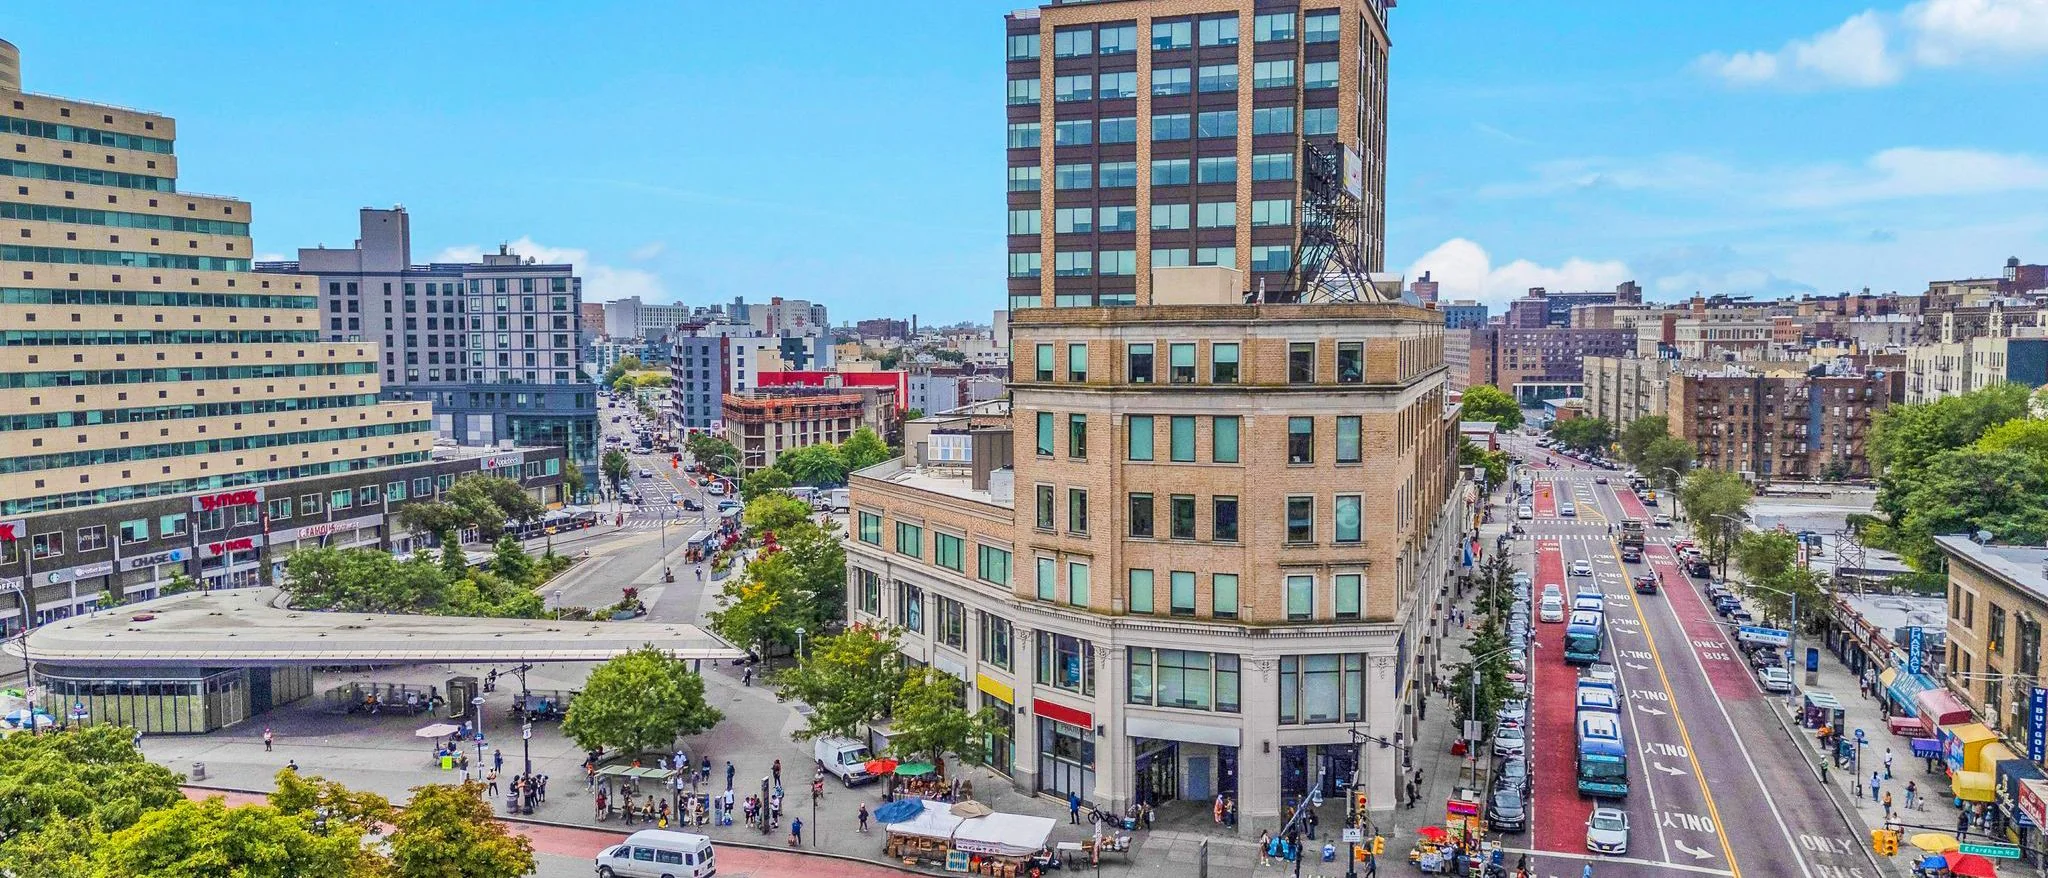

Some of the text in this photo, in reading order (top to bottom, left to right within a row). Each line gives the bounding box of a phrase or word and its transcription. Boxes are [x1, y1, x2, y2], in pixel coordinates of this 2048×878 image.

[132, 554, 169, 567] CHASE
[1610, 618, 1640, 626] ONLY
[1692, 639, 1727, 649] ONLY
[1619, 650, 1653, 659] ONLY
[1702, 651, 1732, 661] BUS
[1910, 627, 1921, 674] PHARMACY
[1630, 689, 1668, 700] ONLY
[2034, 688, 2046, 761] WE BUY GOLD
[1644, 742, 1688, 757] ONLY
[1917, 750, 1940, 759] PIZZA
[1662, 811, 1715, 833] ONLY
[1800, 834, 1853, 855] ONLY
[1971, 846, 2004, 855] Fordham
